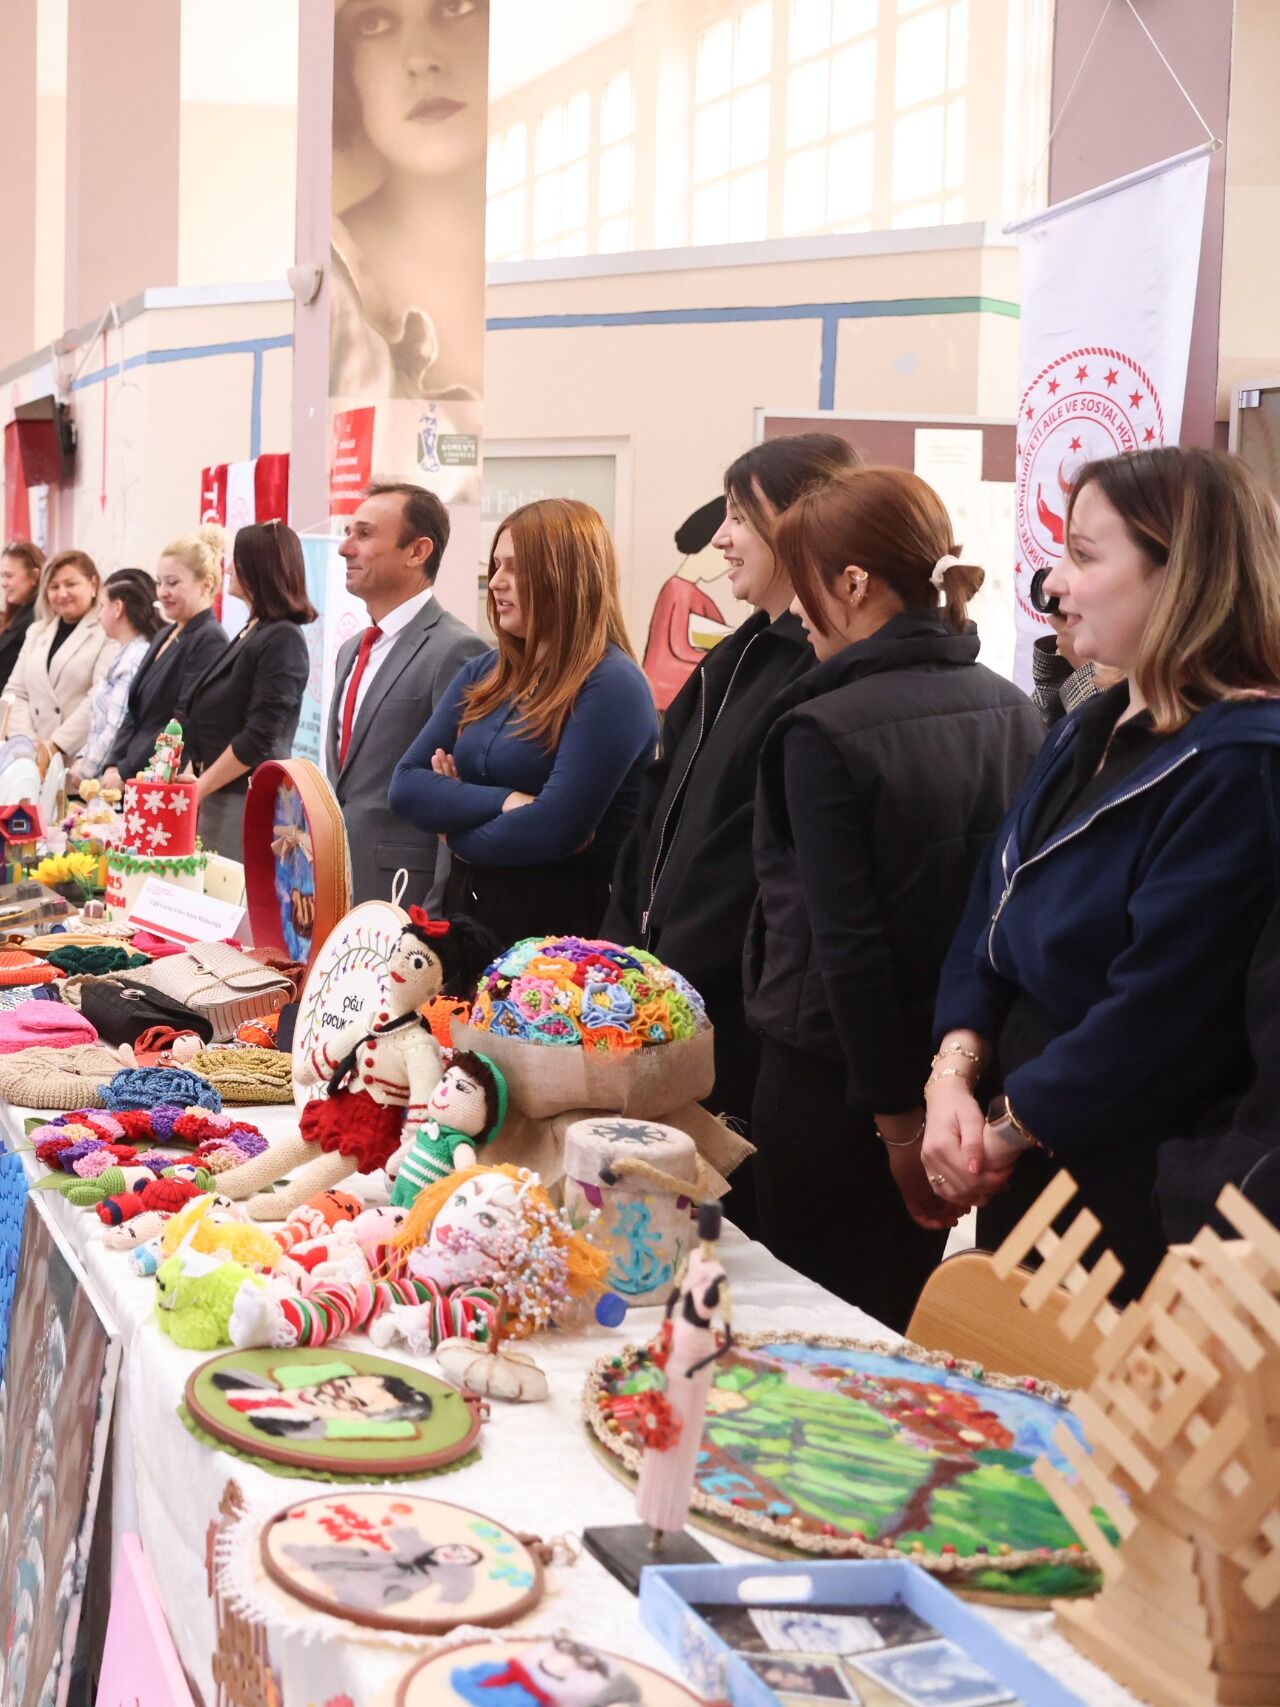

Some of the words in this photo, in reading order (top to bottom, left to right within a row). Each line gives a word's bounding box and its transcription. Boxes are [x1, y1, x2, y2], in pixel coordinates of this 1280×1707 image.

[1043, 406, 1063, 432] AİLE
[1065, 399, 1078, 414] VE
[1080, 398, 1117, 426] SOSYAL
[342, 995, 365, 1013] ÇİĞLİ
[321, 1012, 347, 1030] ÇOCUK
